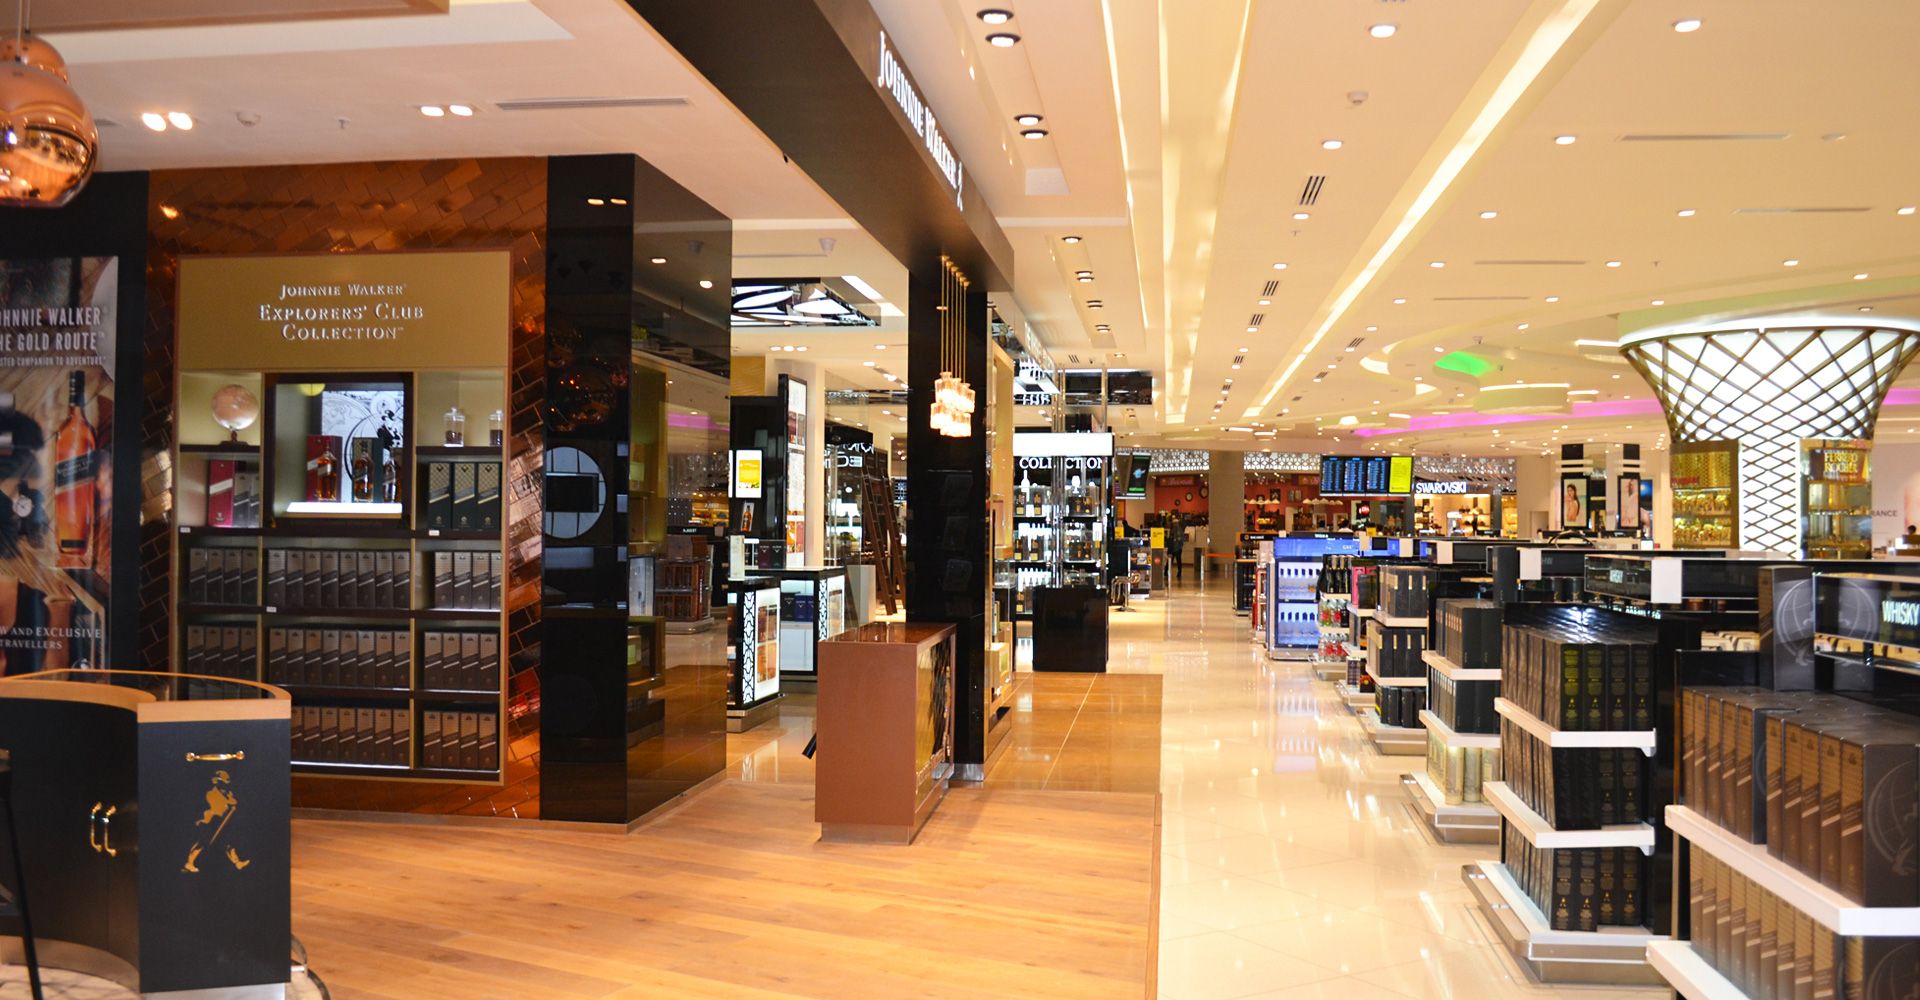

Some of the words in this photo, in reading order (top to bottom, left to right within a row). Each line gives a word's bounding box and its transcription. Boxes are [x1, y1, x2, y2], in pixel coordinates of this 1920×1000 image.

[877, 30, 924, 138] JOHNNIE
[925, 106, 957, 189] WALKER
[279, 284, 341, 300] JOHNNIE
[375, 302, 424, 320] CLUB
[17, 333, 50, 352] GOLD
[1416, 481, 1467, 494] SWAROVSKI
[1882, 600, 1920, 626] WHISKY
[11, 627, 33, 636] AND
[35, 627, 101, 639] EXCLUSIVE
